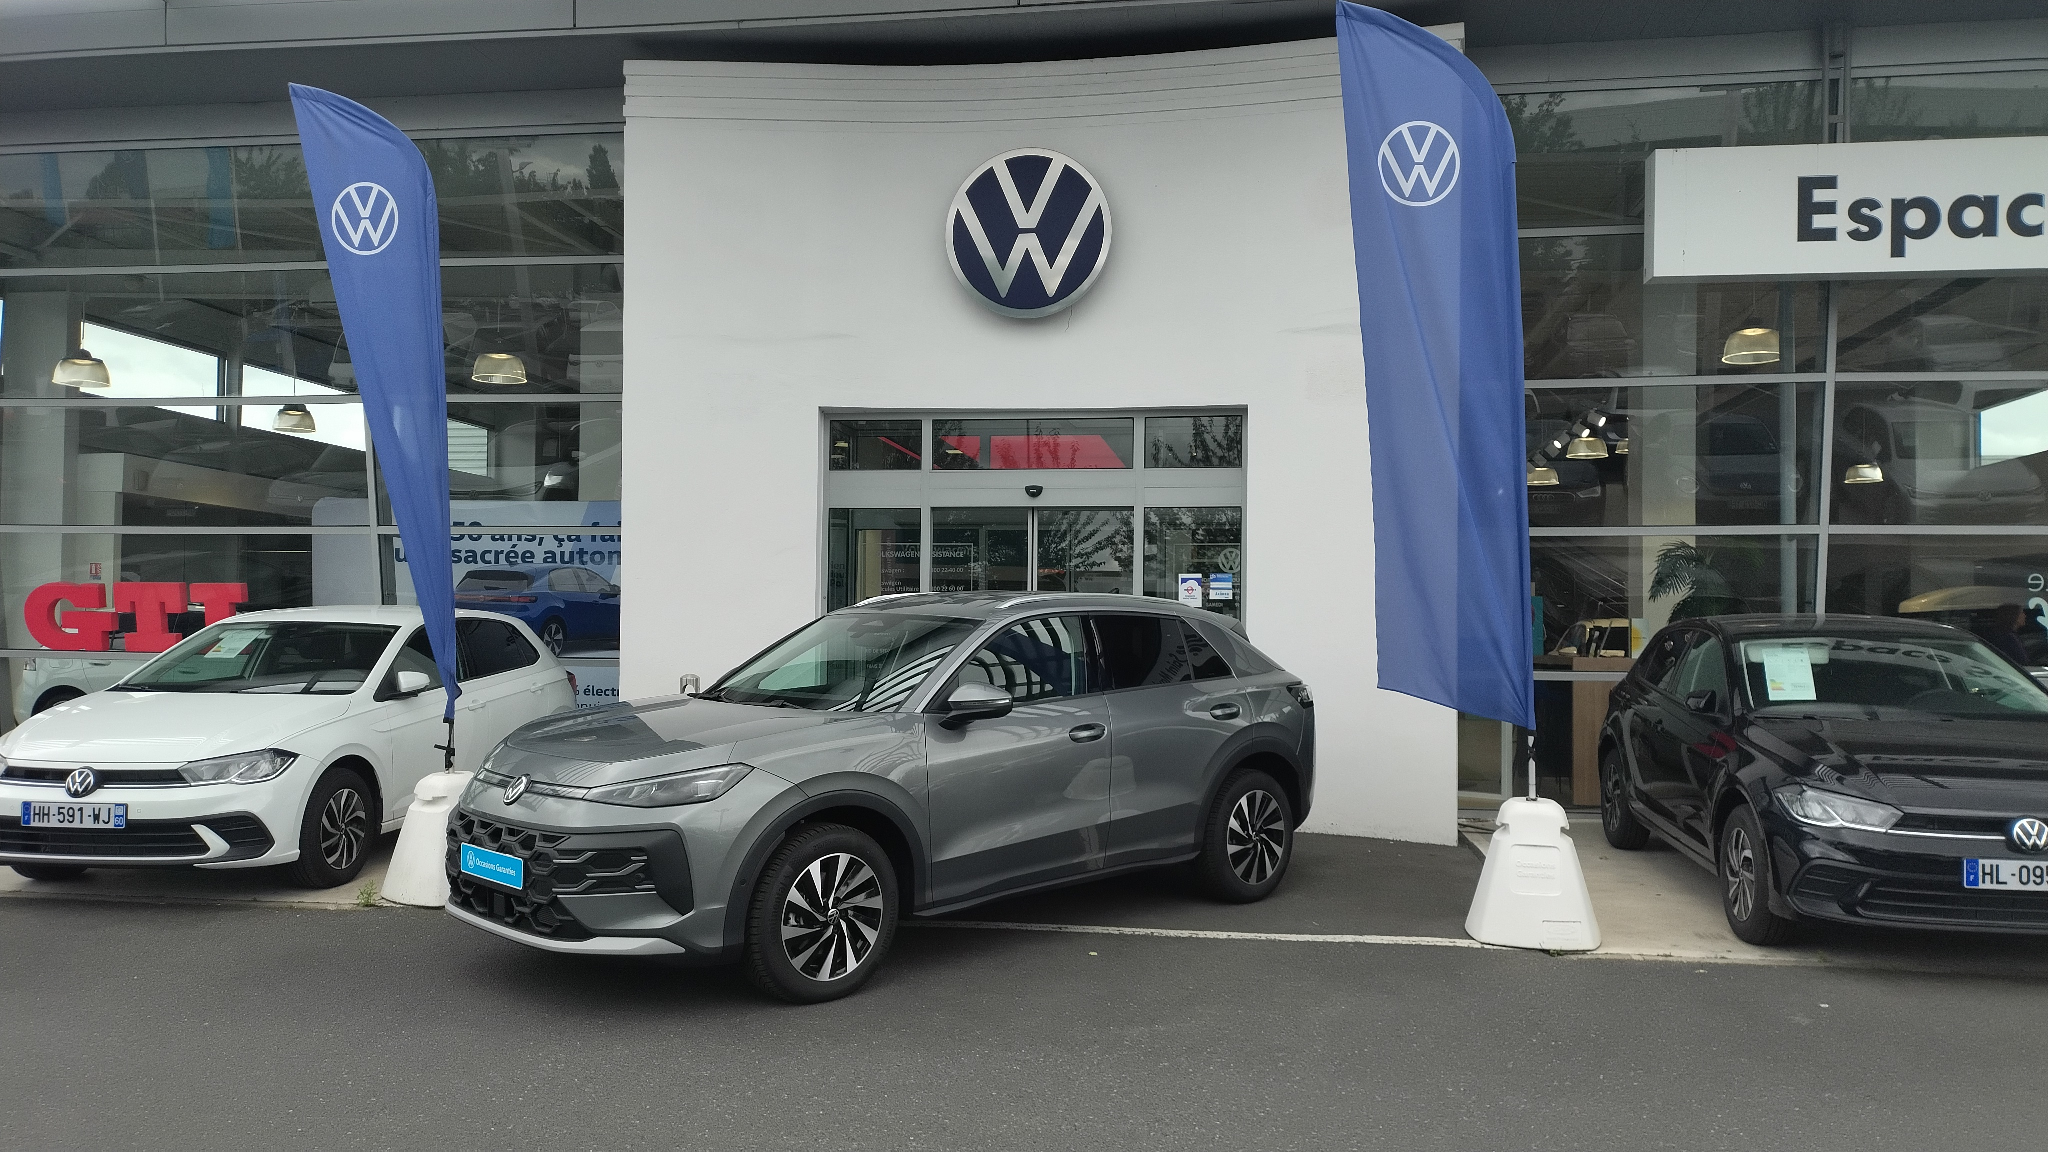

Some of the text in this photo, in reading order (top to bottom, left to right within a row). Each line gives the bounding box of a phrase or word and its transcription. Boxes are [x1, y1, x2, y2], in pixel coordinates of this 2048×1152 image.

[451, 543, 536, 564] sacrée
[32, 805, 112, 825] HH-591-WJ
[114, 816, 124, 826] 60
[475, 857, 516, 877] Occasions Garanties
[1981, 863, 2048, 886] HL-09
